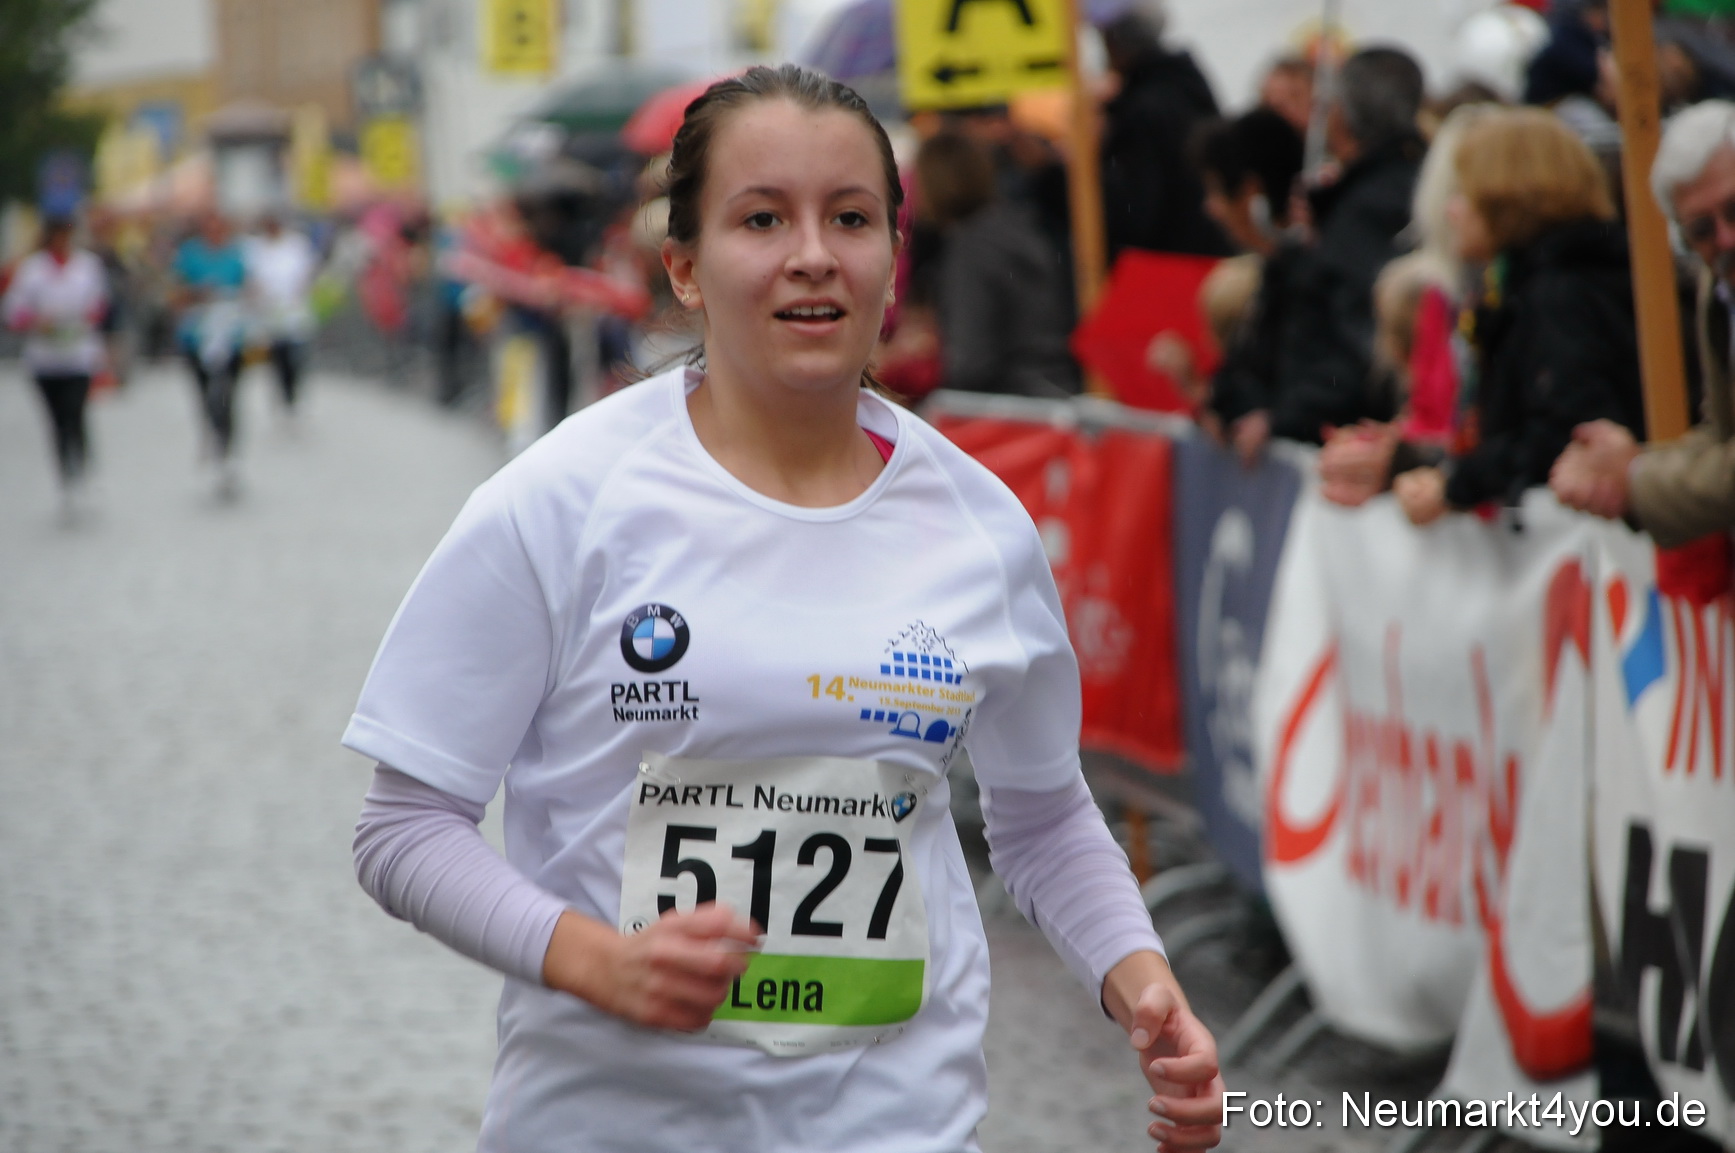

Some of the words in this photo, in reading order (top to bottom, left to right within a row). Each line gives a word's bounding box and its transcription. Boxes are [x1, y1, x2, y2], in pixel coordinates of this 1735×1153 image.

[626, 604, 685, 629] BMW
[610, 680, 700, 705] PARTL
[806, 673, 855, 702] 14.
[848, 675, 937, 699] Neumarkter
[612, 704, 700, 722] Neumarkt
[639, 782, 744, 808] PARTL
[657, 823, 904, 940] 5127
[731, 975, 824, 1013] Lena
